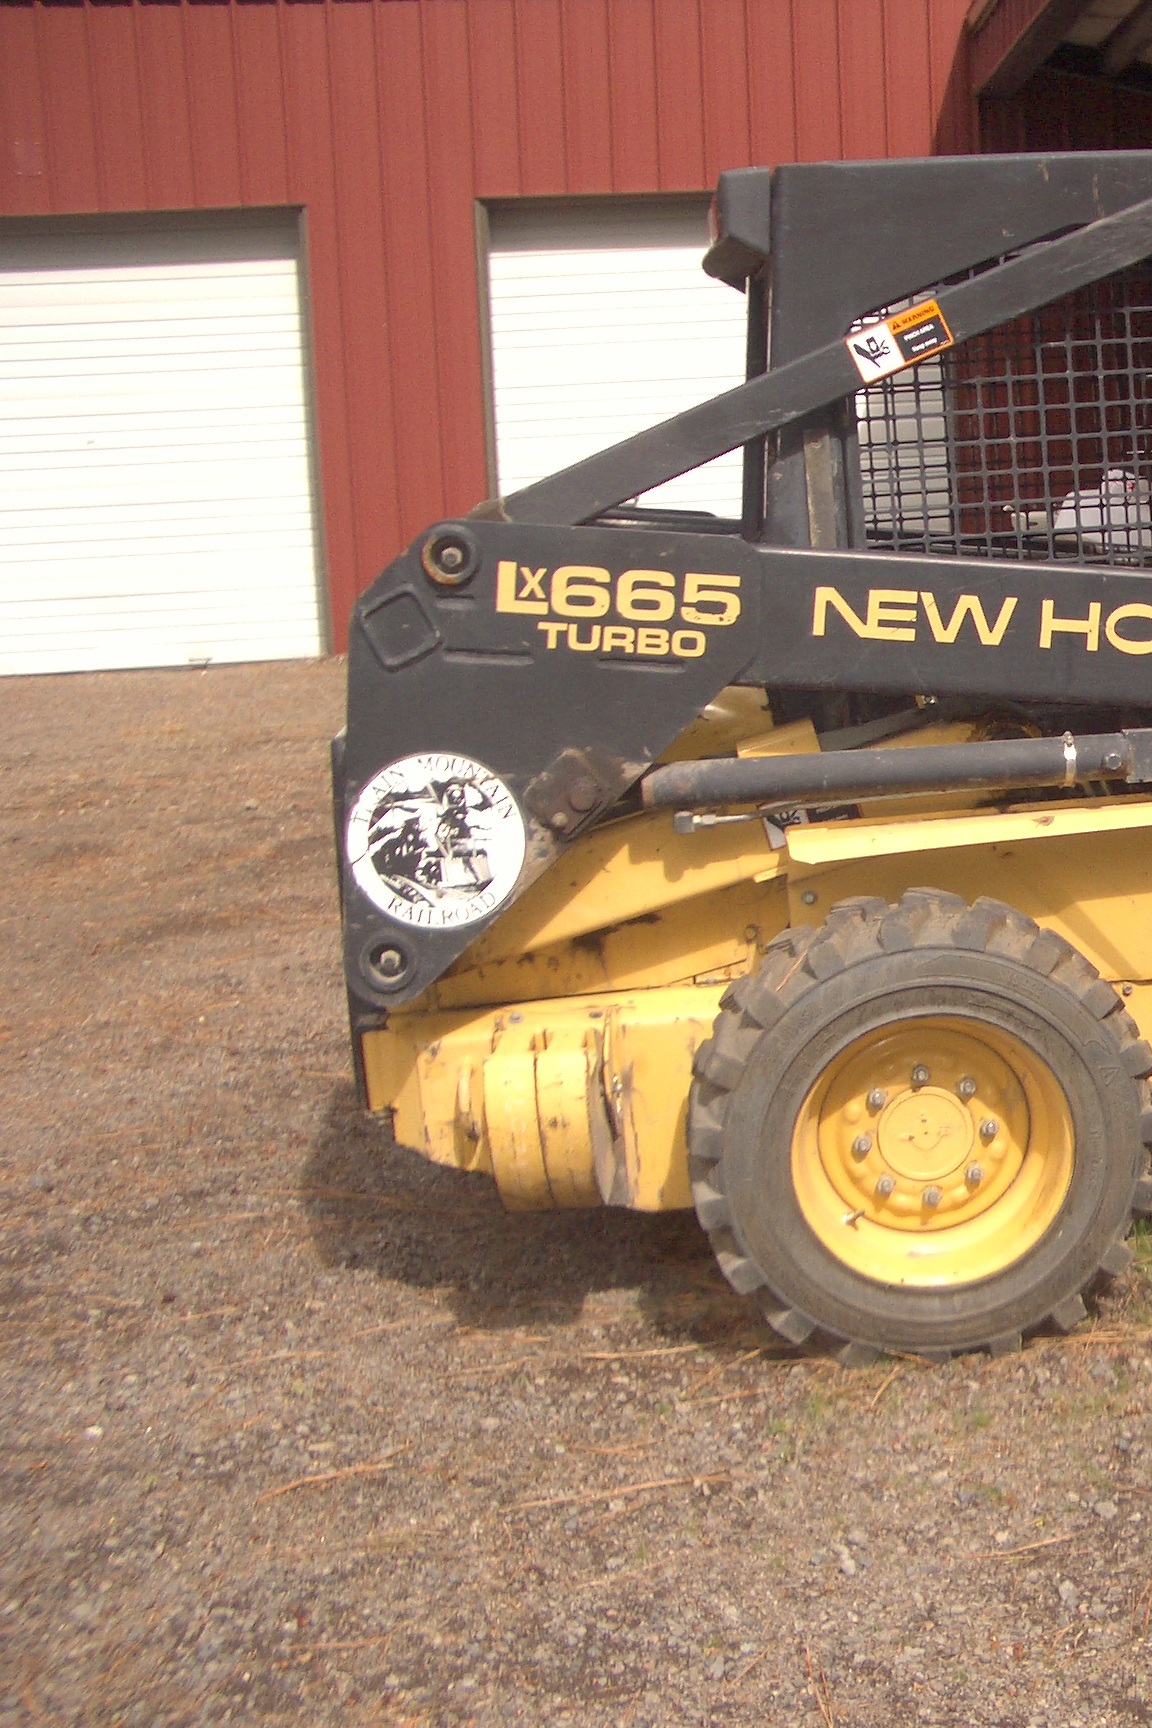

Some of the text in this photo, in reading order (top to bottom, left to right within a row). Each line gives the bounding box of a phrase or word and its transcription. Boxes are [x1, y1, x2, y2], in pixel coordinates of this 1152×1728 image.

[901, 305, 935, 324] WARNING
[813, 586, 1018, 645] NEW
[537, 621, 706, 658] TURBO
[417, 755, 517, 820] MOUNTAIN
[387, 891, 497, 925] RAILROAD
